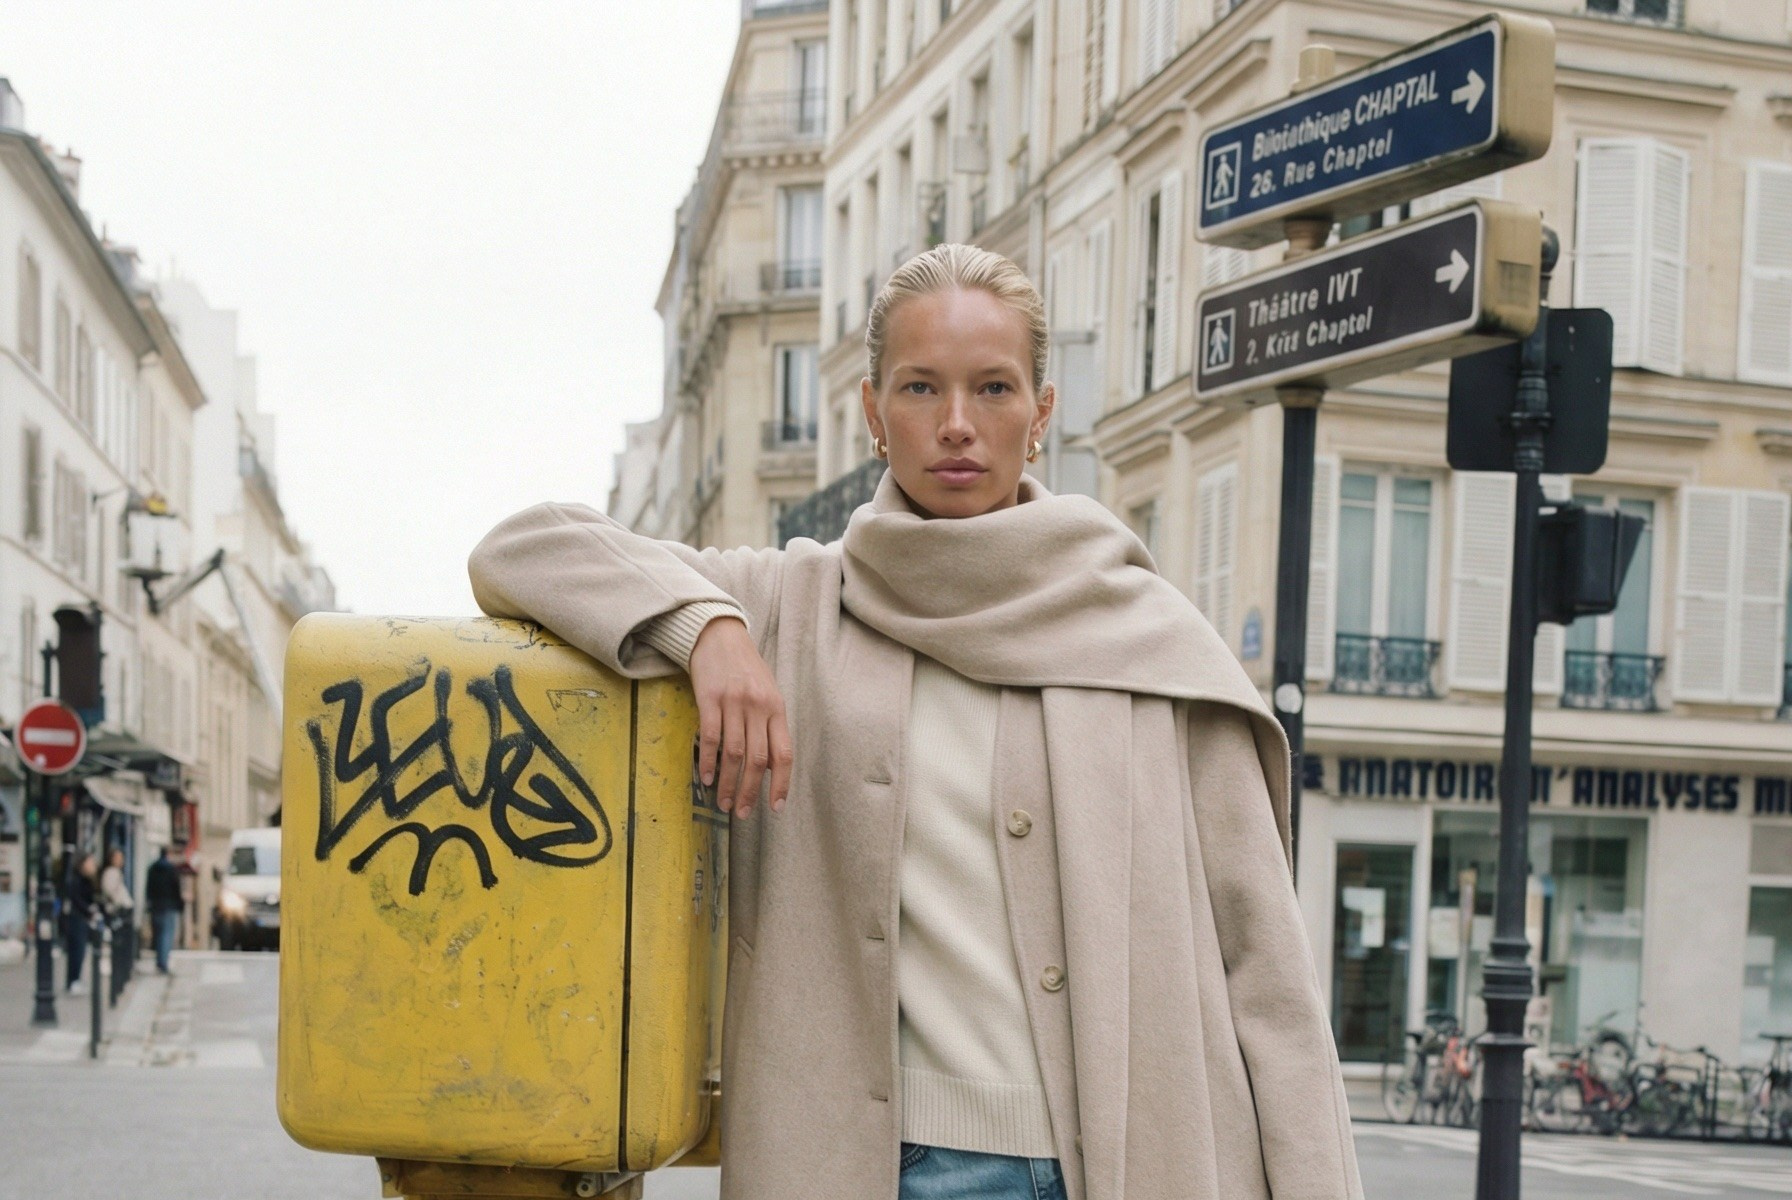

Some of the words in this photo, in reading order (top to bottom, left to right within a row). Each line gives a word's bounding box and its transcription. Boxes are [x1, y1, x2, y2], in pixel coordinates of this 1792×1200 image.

[1354, 70, 1439, 126] CHAPTAL
[1283, 161, 1316, 187] Rue
[1327, 267, 1363, 305] IVT
